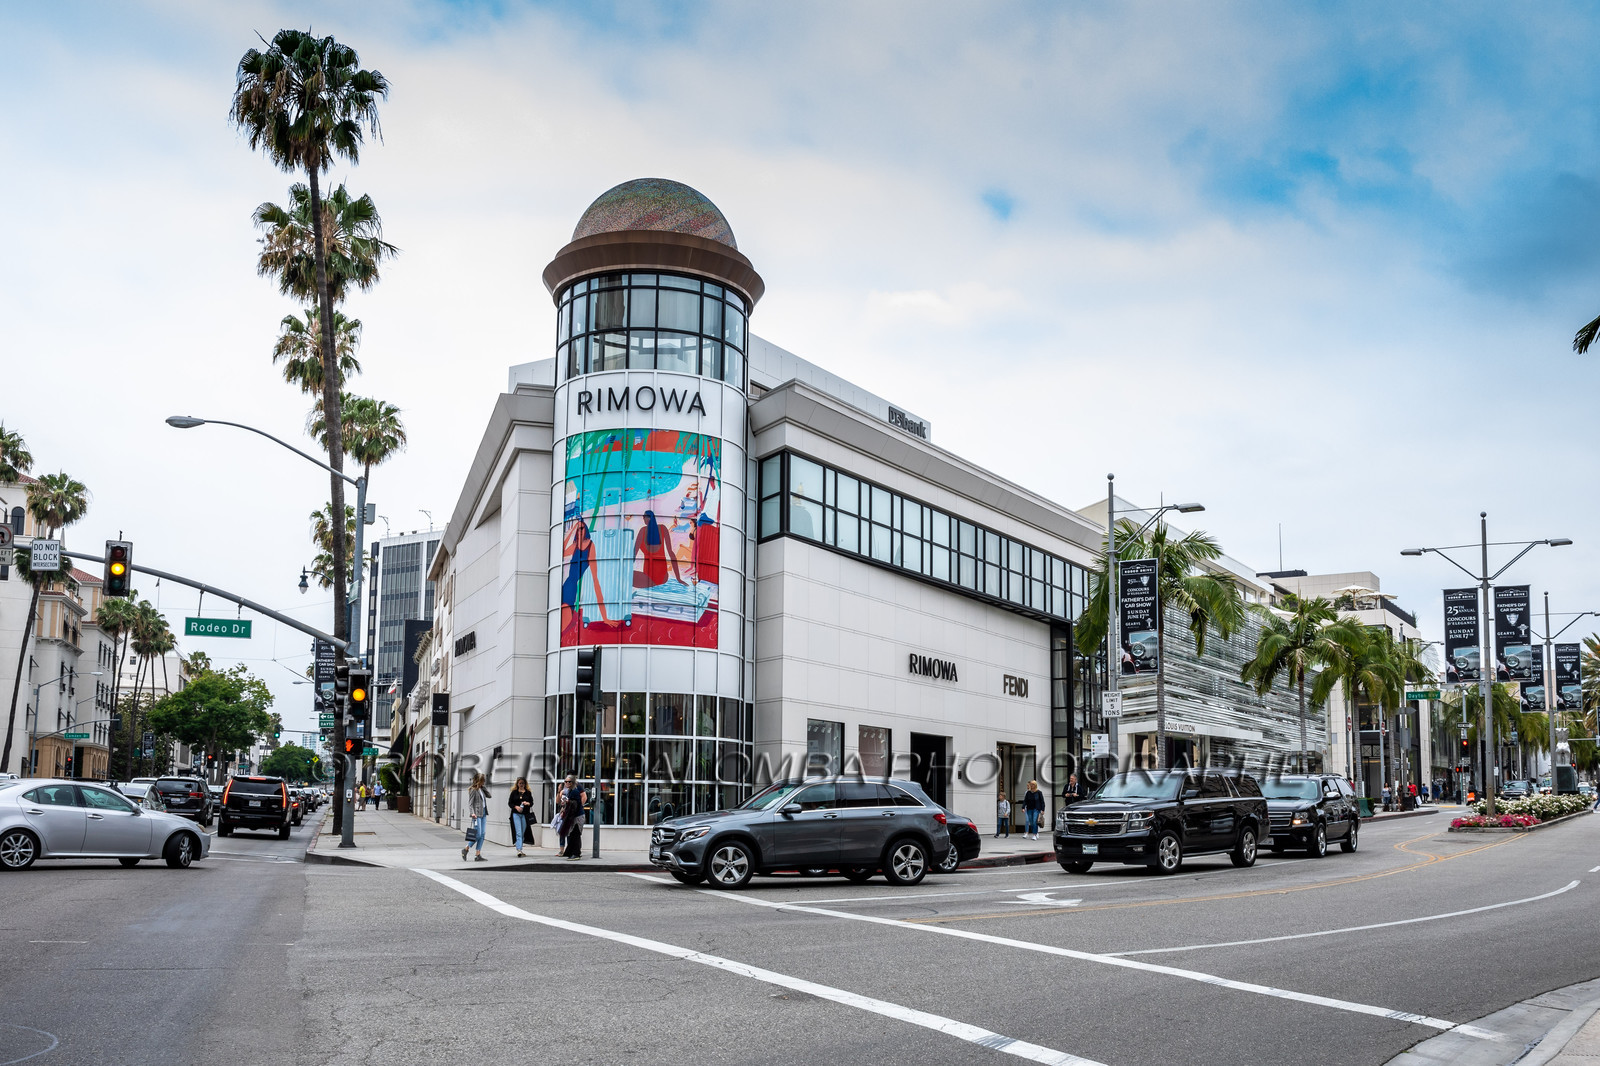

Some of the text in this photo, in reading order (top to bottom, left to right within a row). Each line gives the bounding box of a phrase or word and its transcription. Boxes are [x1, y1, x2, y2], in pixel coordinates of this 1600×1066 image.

[577, 385, 707, 417] RIMOWA
[33, 543, 58, 551] DO NOT
[33, 553, 58, 561] BLOCK
[190, 621, 246, 634] Rodeo Dr
[908, 653, 958, 682] RIMOWA
[1003, 673, 1029, 699] FENDI
[1165, 721, 1196, 733] LOUIS VUITTON
